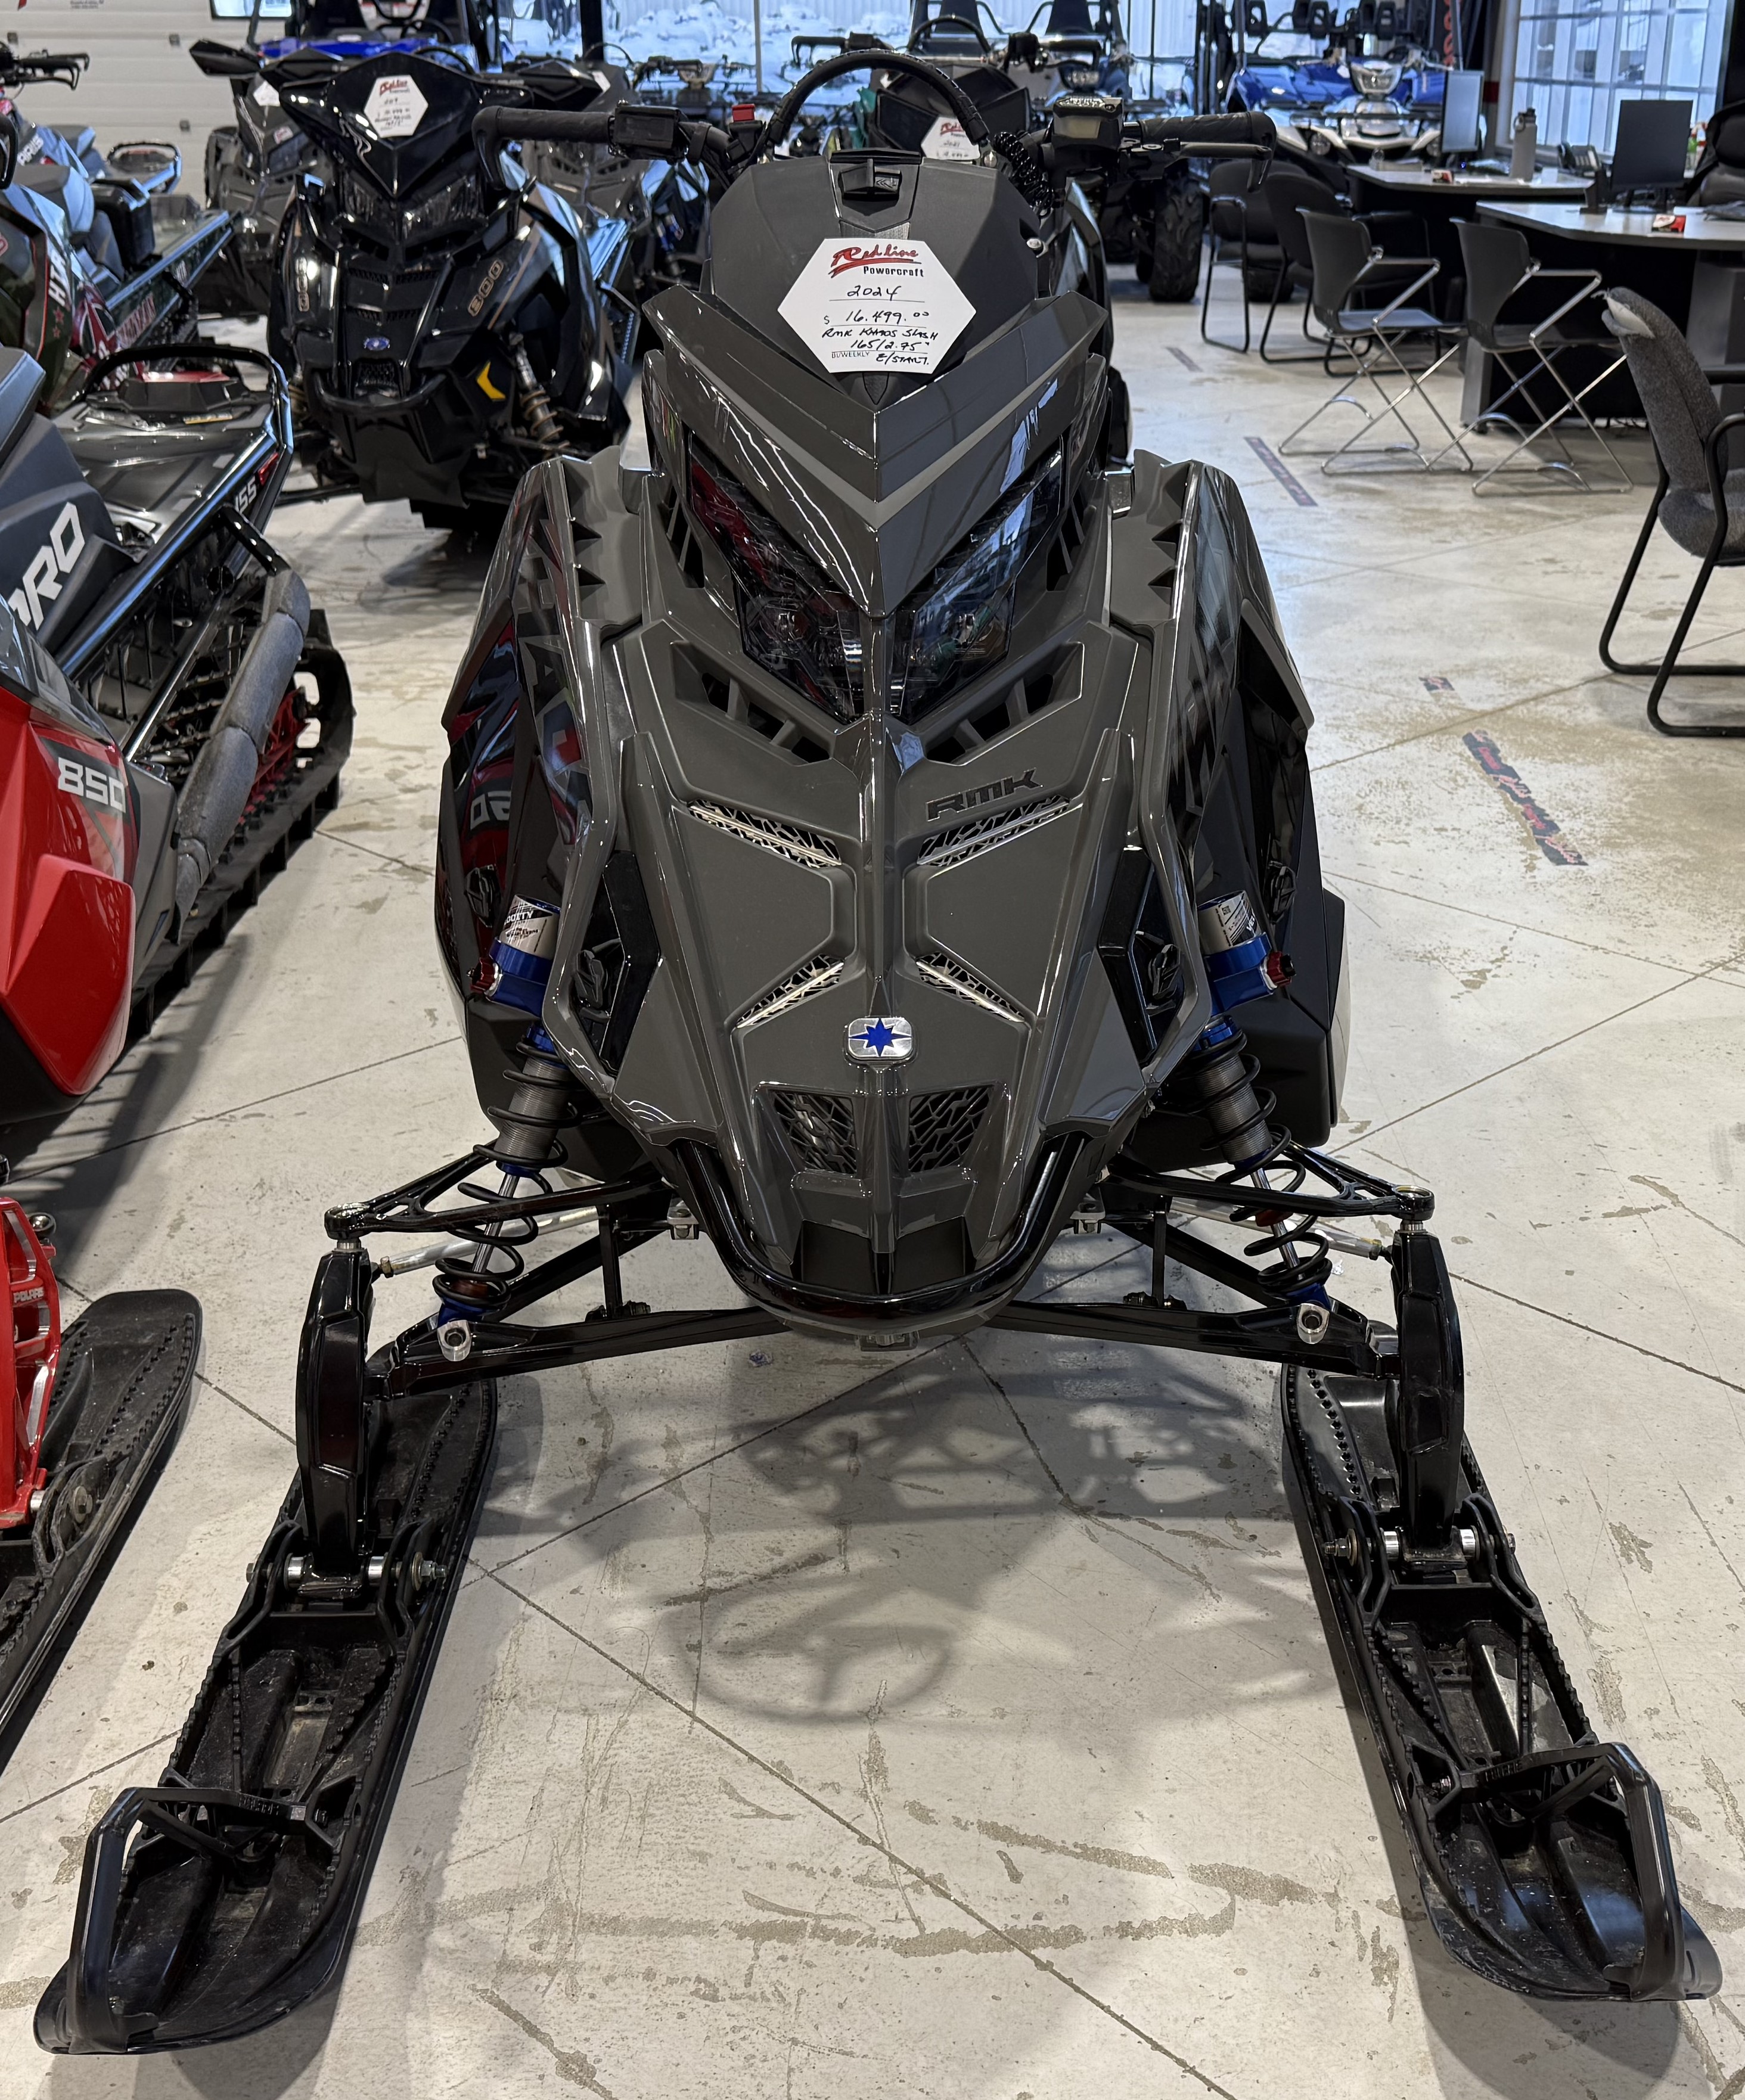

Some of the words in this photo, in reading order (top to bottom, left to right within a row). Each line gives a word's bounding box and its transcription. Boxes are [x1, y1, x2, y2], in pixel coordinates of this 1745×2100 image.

[831, 244, 919, 268] Redline
[864, 266, 924, 277] Powercraft
[847, 285, 902, 301] 2024
[58, 757, 126, 813] 850
[926, 768, 1043, 822] RMK
